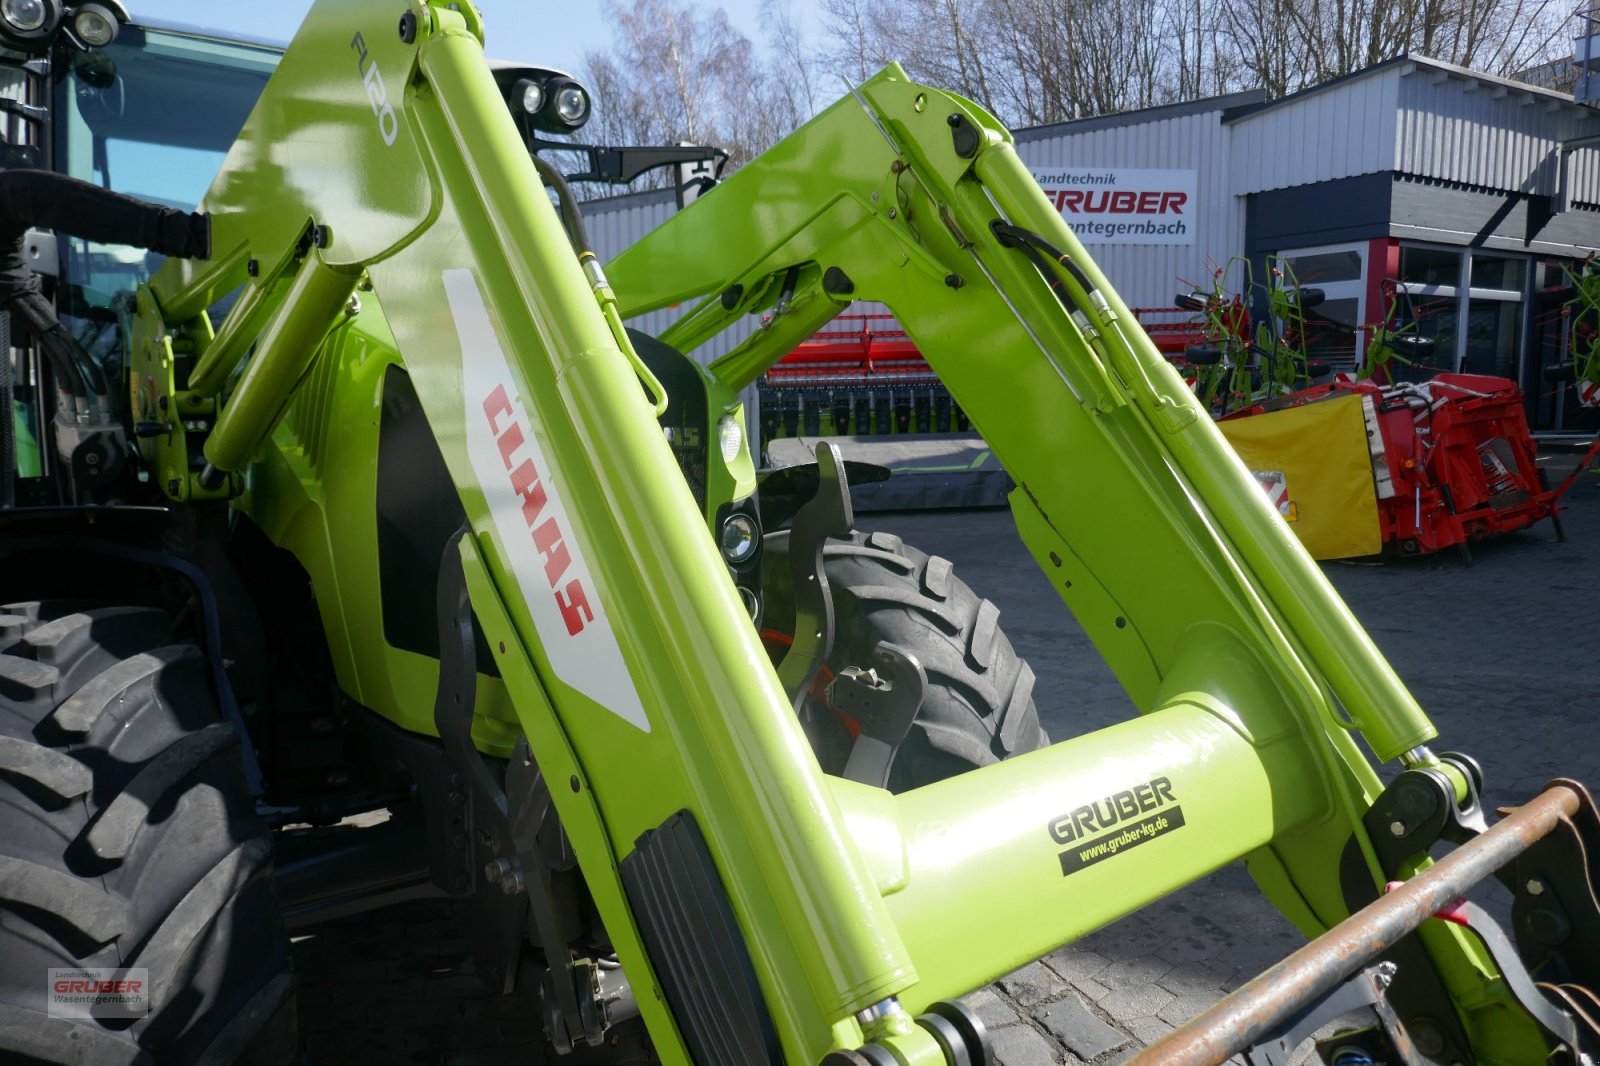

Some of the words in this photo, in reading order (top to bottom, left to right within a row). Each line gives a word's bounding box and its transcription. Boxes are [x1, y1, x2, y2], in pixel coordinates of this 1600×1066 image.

[482, 383, 595, 637] CLAAS
[1048, 776, 1177, 845] GRUBER
[1079, 816, 1169, 862] www.gruber-kg.de
